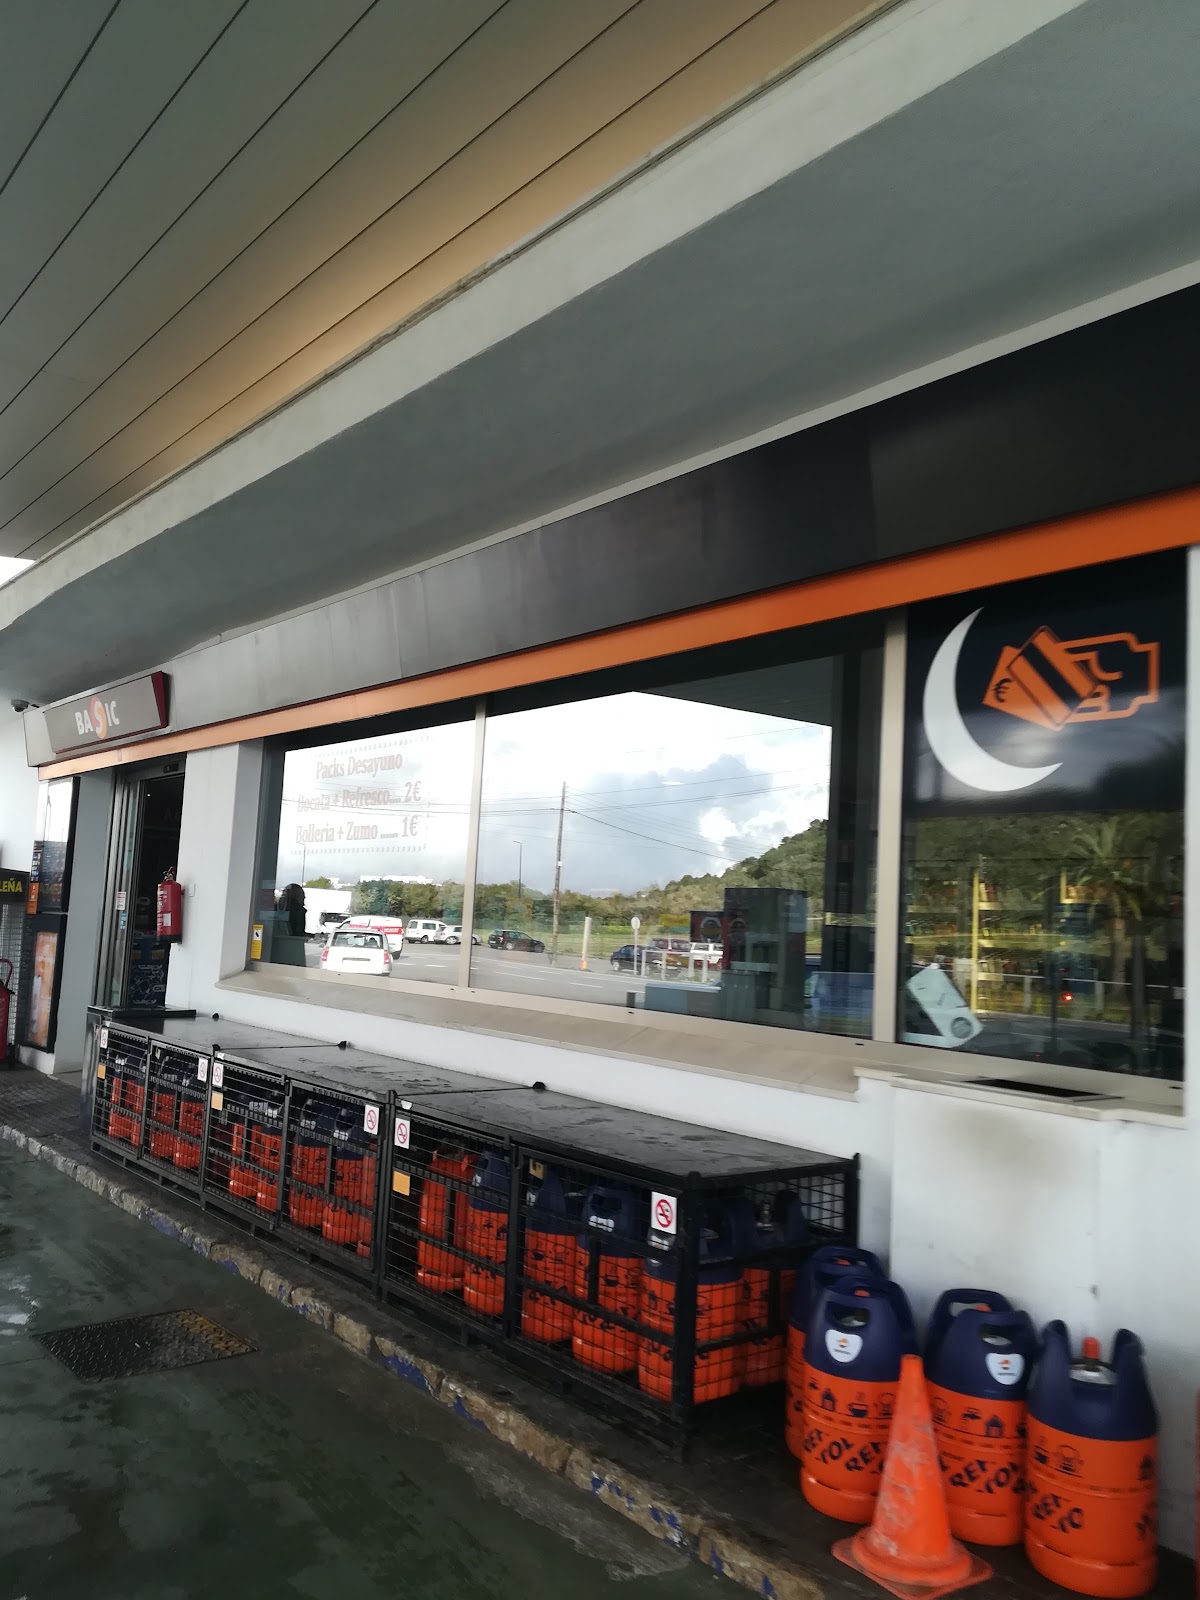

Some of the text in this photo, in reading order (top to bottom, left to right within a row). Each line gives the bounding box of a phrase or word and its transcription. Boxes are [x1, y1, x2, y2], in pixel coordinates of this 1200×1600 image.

[75, 700, 120, 735] BASIC
[315, 753, 403, 779] Packs Desayuno
[404, 780, 422, 803] 2€
[337, 826, 344, 840] +
[346, 821, 379, 841] Zumo
[401, 815, 419, 838] 1€
